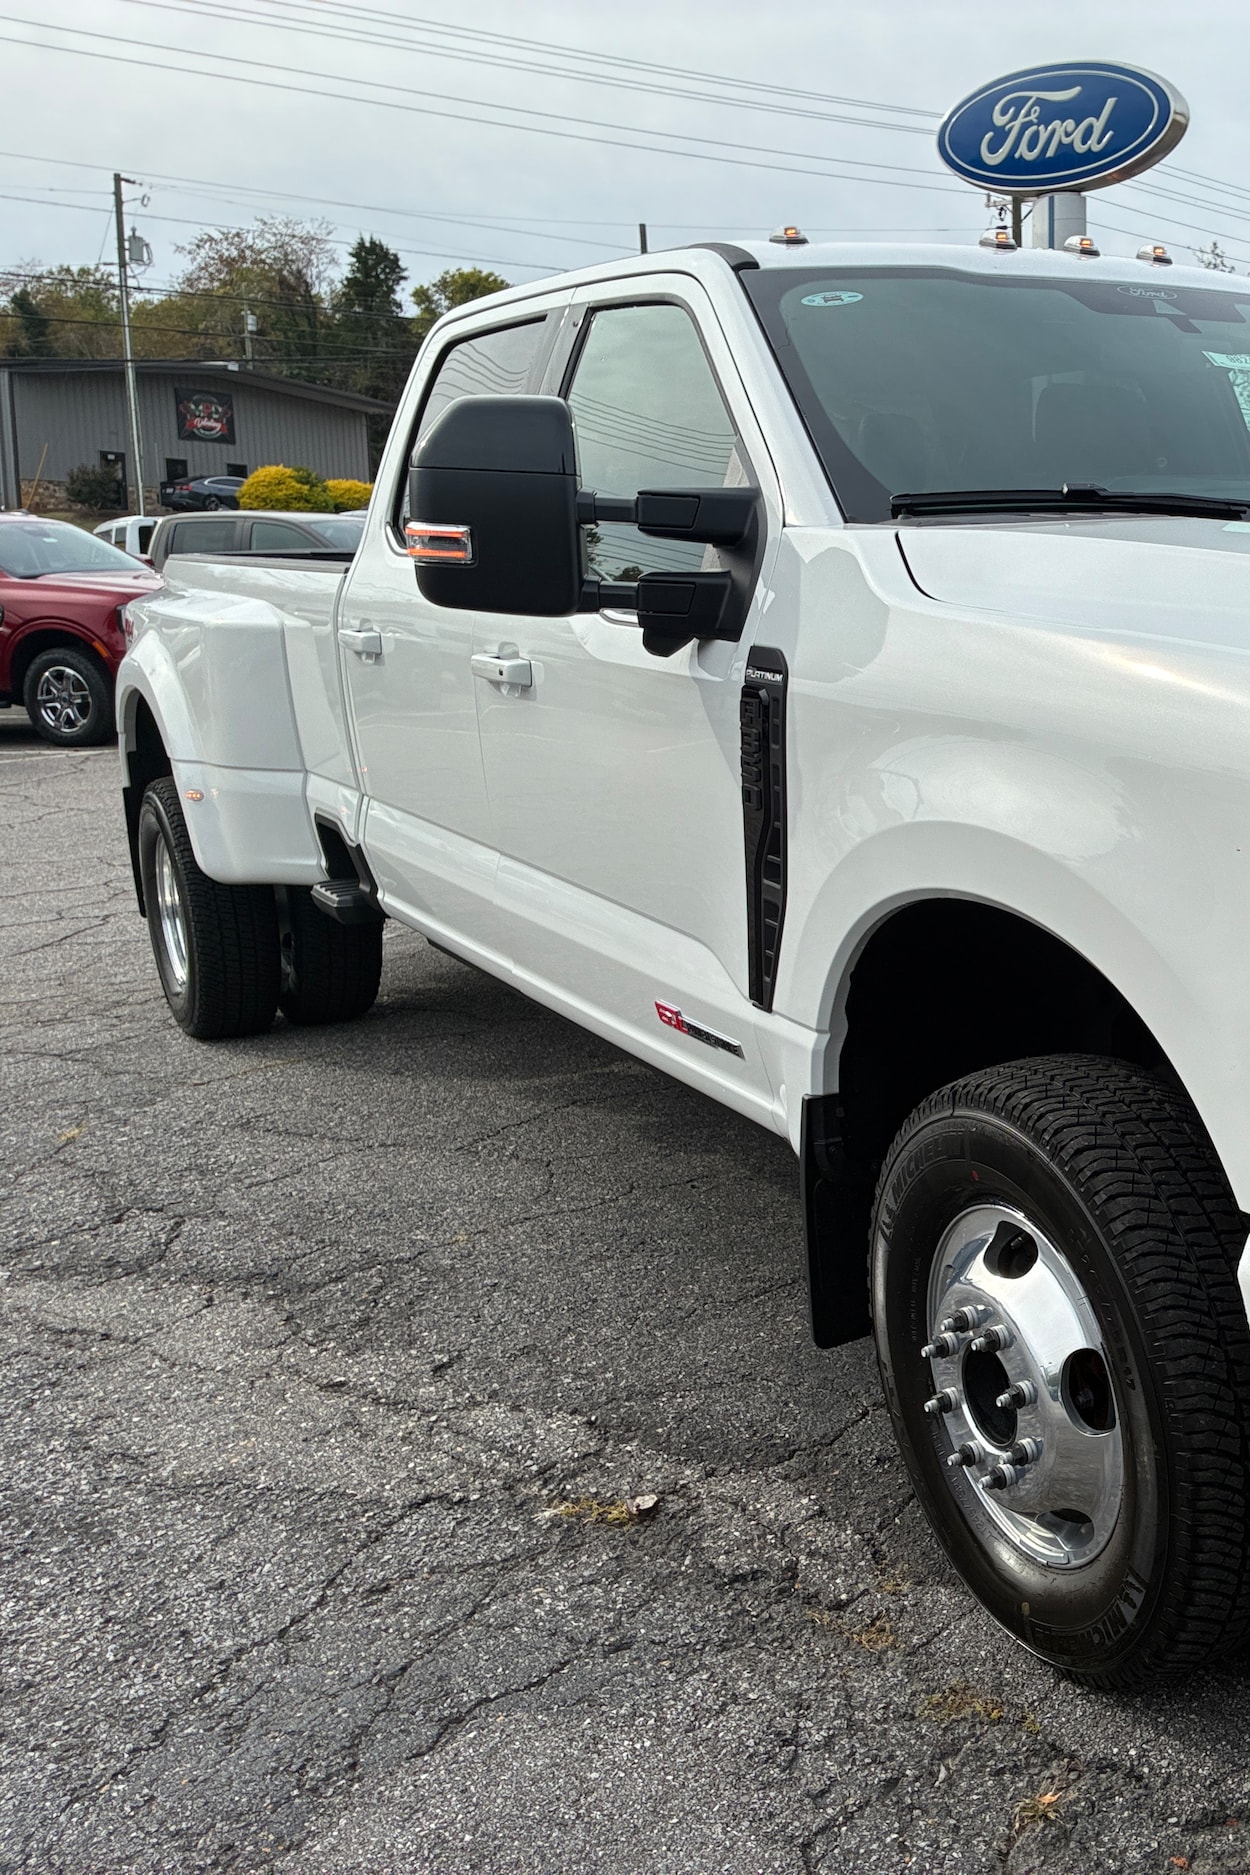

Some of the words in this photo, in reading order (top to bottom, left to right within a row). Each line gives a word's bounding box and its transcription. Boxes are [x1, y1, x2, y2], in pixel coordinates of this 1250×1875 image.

[980, 86, 1118, 166] Ford
[1129, 287, 1168, 298] Ford
[746, 668, 783, 682] PLATINUM
